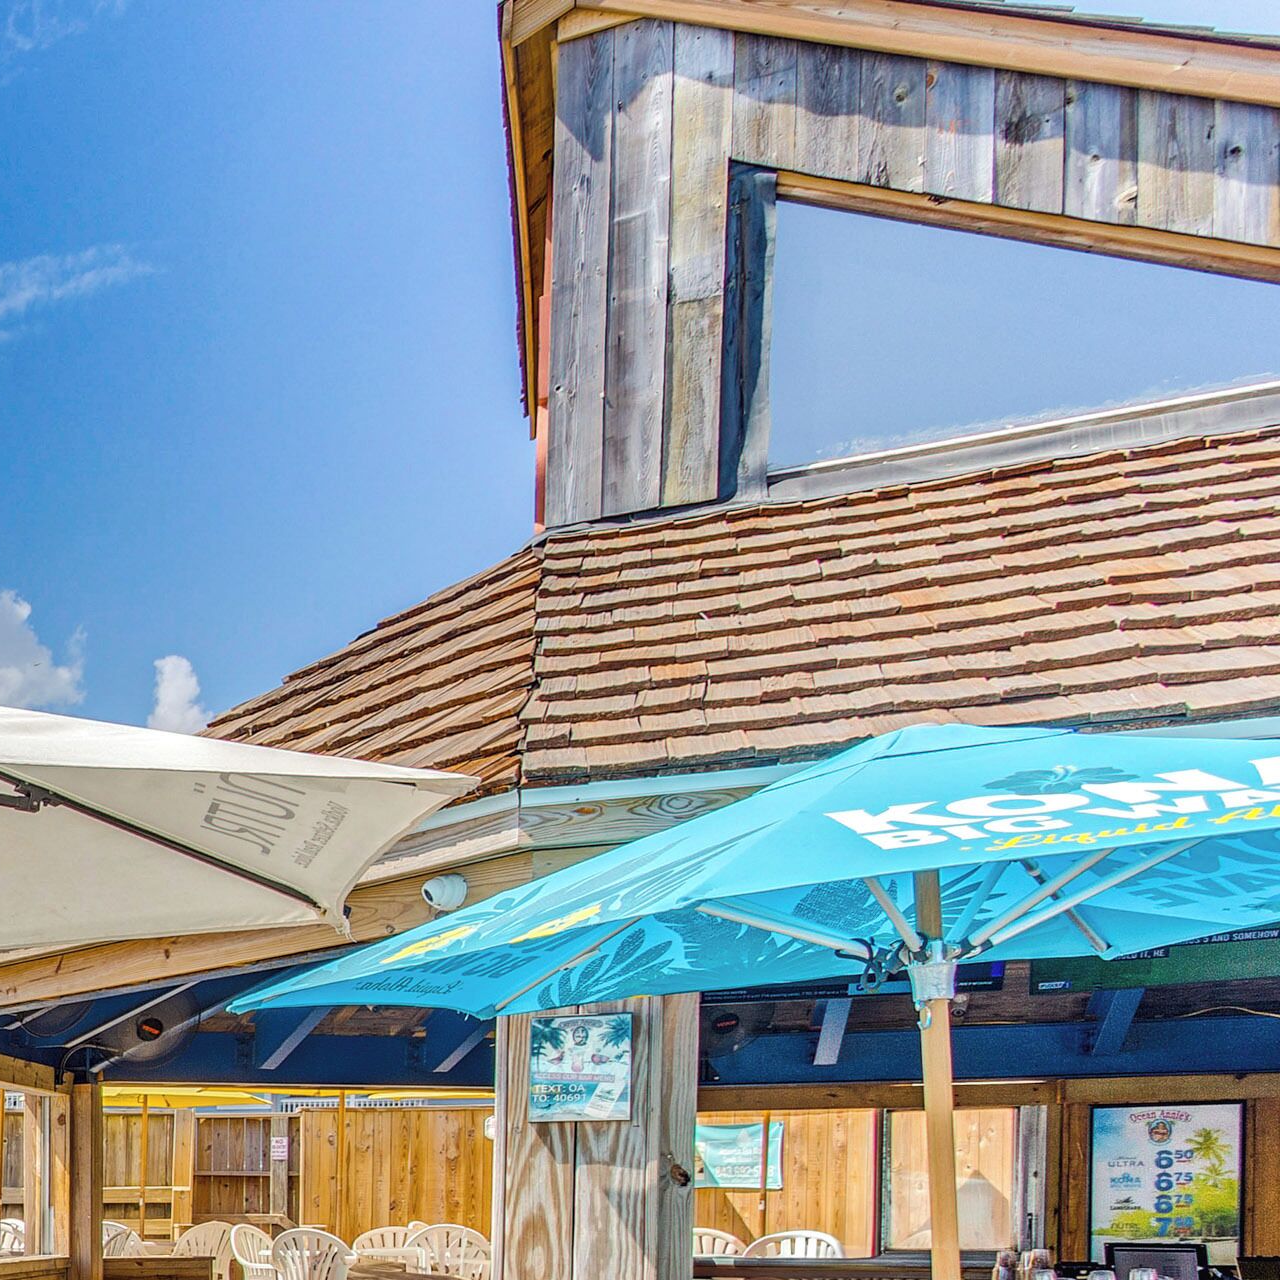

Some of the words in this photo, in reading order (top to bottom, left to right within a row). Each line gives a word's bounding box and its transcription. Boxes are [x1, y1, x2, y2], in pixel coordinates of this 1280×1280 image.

[861, 815, 1073, 851] BIG
[1211, 935, 1230, 943] AND
[1232, 929, 1280, 941] SOMEHOW
[533, 1084, 567, 1093] TEXT:
[568, 1084, 586, 1093] OA
[532, 1094, 550, 1103] TO:
[553, 1094, 586, 1102] 40691
[1129, 1112, 1157, 1122] Ocean
[1160, 1110, 1192, 1122] Annie's
[1108, 1160, 1145, 1168] ULTRA
